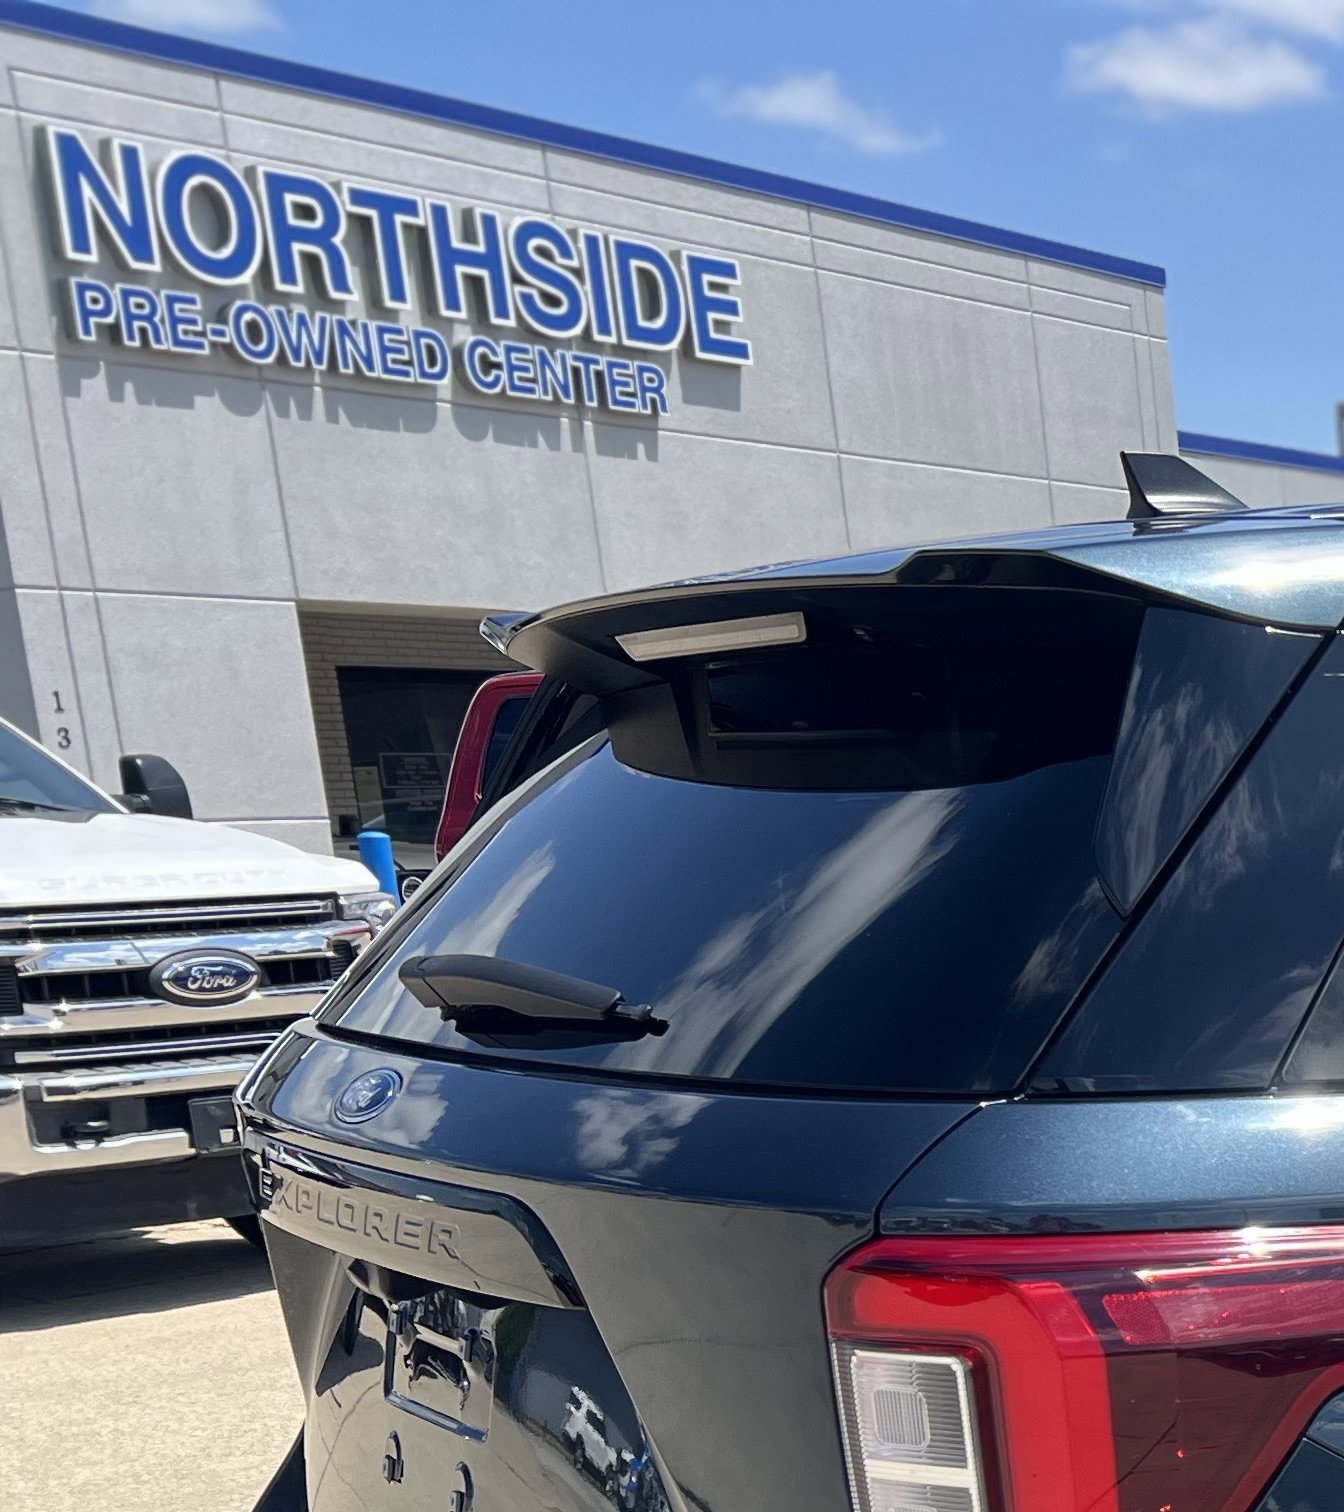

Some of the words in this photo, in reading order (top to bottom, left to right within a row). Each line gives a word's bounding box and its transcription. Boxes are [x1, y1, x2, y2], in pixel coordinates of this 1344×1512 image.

[46, 124, 754, 366] NORTHSIDE
[69, 276, 450, 385] PRE-OWNED
[464, 336, 671, 416] CENTER
[187, 964, 237, 990] Ford
[259, 1167, 462, 1260] EXPLORER
